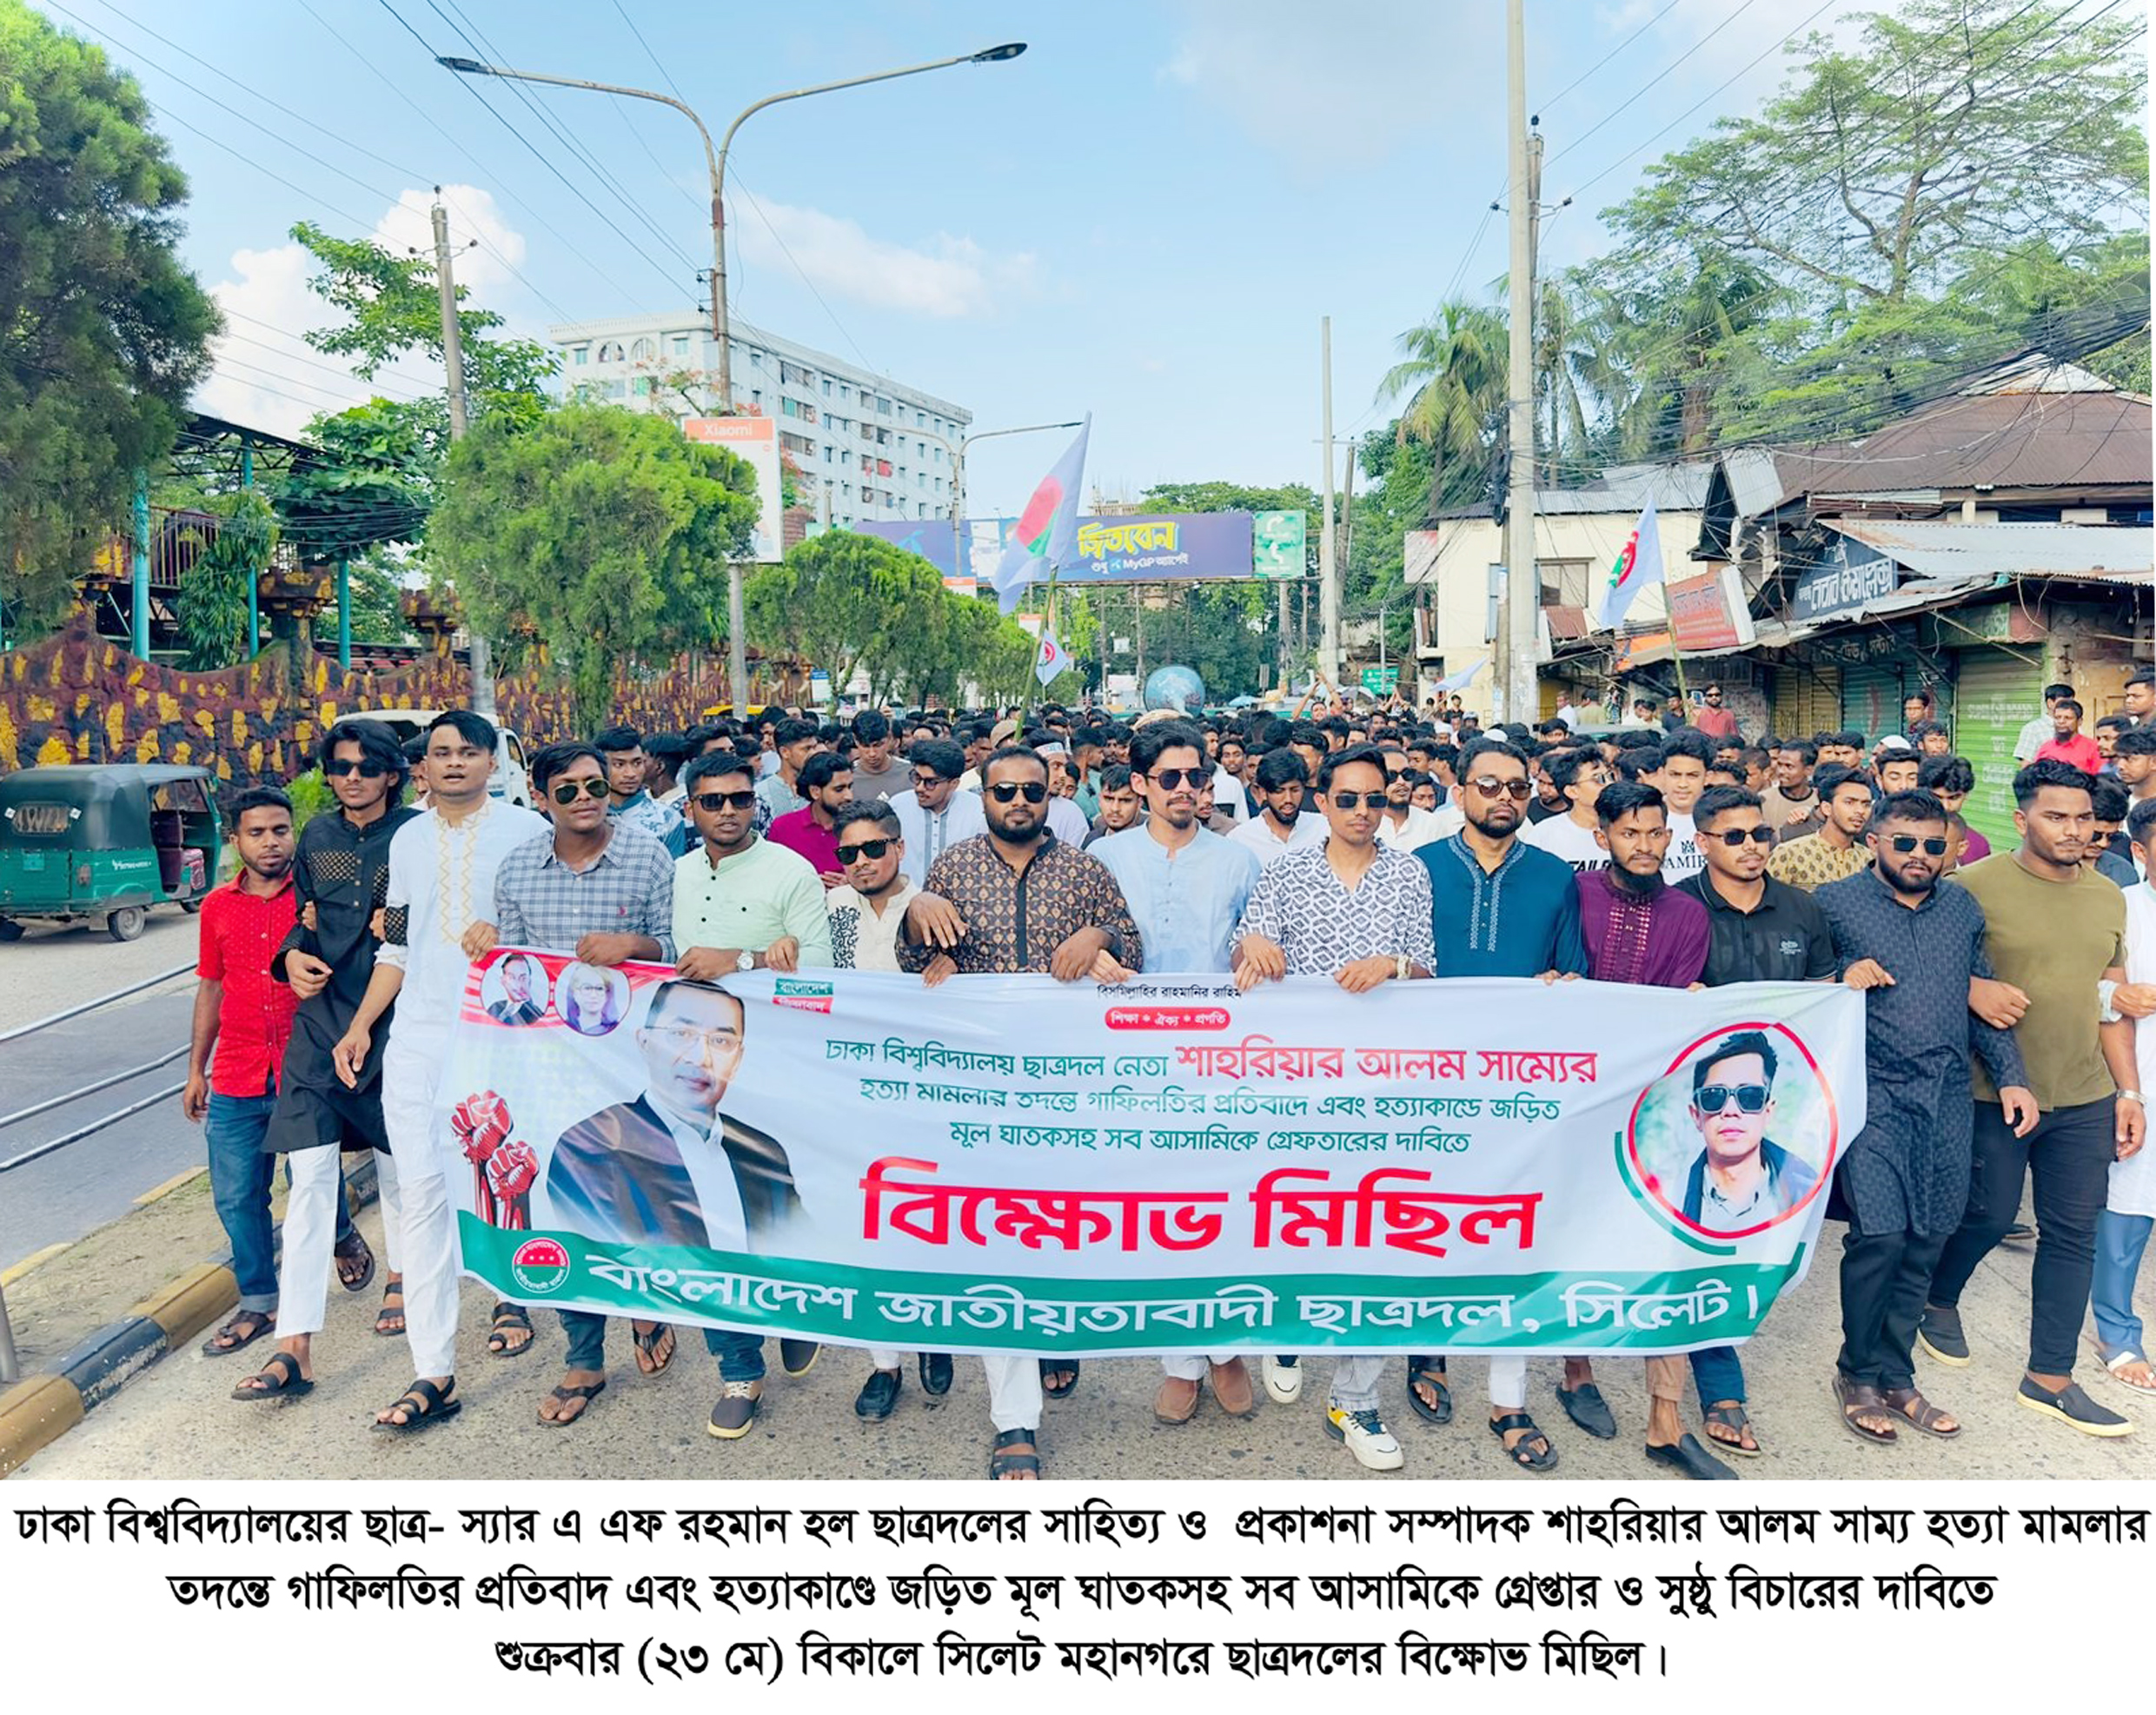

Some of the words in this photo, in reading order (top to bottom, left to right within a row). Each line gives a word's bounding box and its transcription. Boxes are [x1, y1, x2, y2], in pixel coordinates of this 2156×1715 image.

[705, 422, 753, 436] Xiaomi
[1123, 556, 1155, 570] MyGP
[1161, 984, 1209, 1000] রাহমানির
[1111, 1010, 1139, 1025] শিক্ষা
[1194, 1011, 1227, 1025] প্রগতি
[826, 1039, 875, 1062] ঢাকা
[882, 1037, 1015, 1073] বিশ্ববিদ্যালয়
[1023, 1055, 1105, 1080] ছাত্রদল
[1113, 1055, 1169, 1077] নেতা
[1175, 1034, 1345, 1080] শাহরিয়ার
[1355, 1048, 1467, 1080] আলম
[1476, 1051, 1597, 1083] সাম্যের
[860, 1078, 909, 1101] হত্যা
[916, 1082, 1008, 1107] মামলার
[1014, 1092, 1078, 1113] তদন্তে
[1087, 1085, 1207, 1113] গাফিলতির
[1213, 1086, 1309, 1116] প্রতিবাদে
[1317, 1096, 1367, 1119] এবং
[1489, 1091, 1562, 1123] জড়িত
[950, 1121, 992, 1149] মূল
[998, 1124, 1098, 1150] ঘাতকসহ
[1104, 1129, 1143, 1150] সব
[1150, 1123, 1260, 1150] আসামিকে
[1267, 1131, 1389, 1153] গ্রেফতারের
[1396, 1125, 1472, 1153] দাবিতে
[859, 1156, 1230, 1252] বিক্ষোভ
[1248, 1167, 1544, 1259] মিছিল
[585, 1254, 859, 1319] বাংলাদেশ
[874, 1283, 1279, 1336] জাতীয়তাবাদী
[1297, 1293, 1540, 1333] ছাত্রদল,
